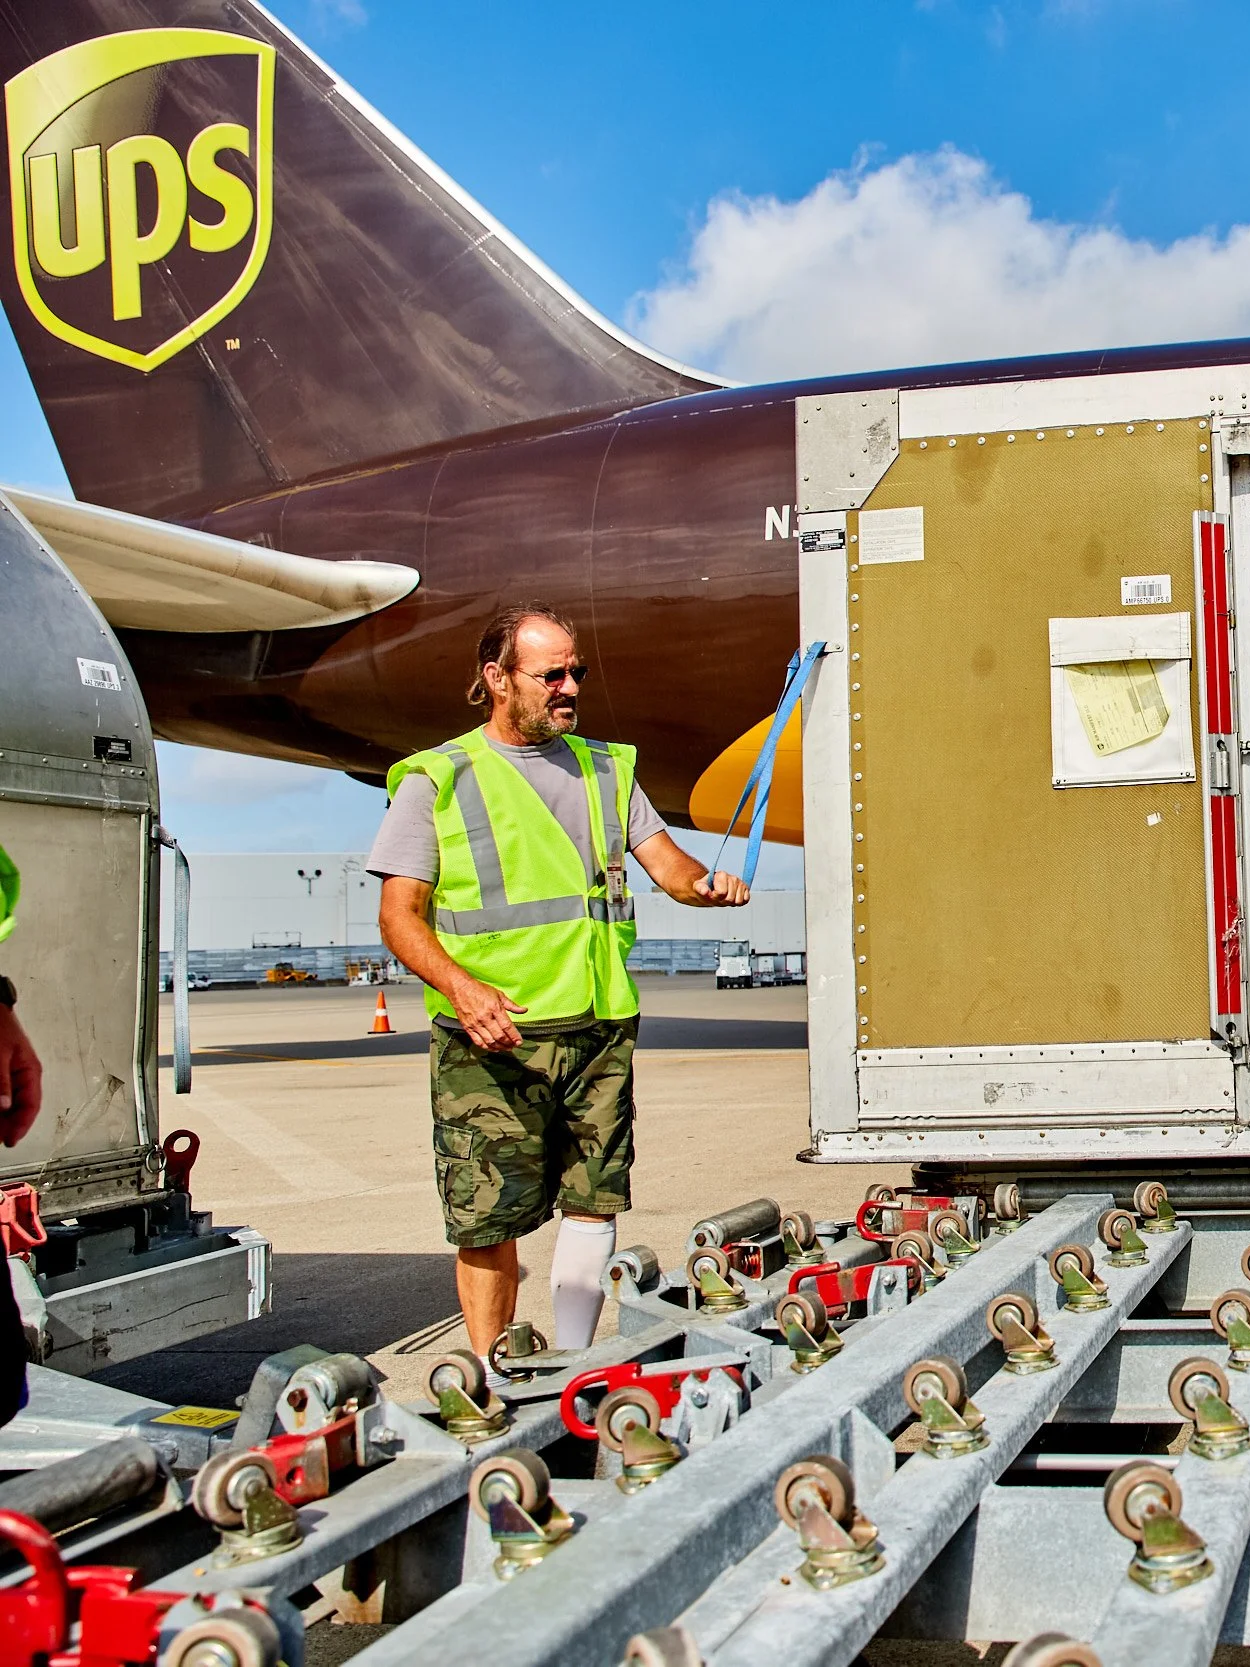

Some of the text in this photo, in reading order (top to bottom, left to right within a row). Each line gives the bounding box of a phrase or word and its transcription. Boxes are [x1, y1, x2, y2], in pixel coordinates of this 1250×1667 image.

[29, 122, 255, 321] ups
[225, 337, 240, 350] TM
[764, 504, 799, 541] N
